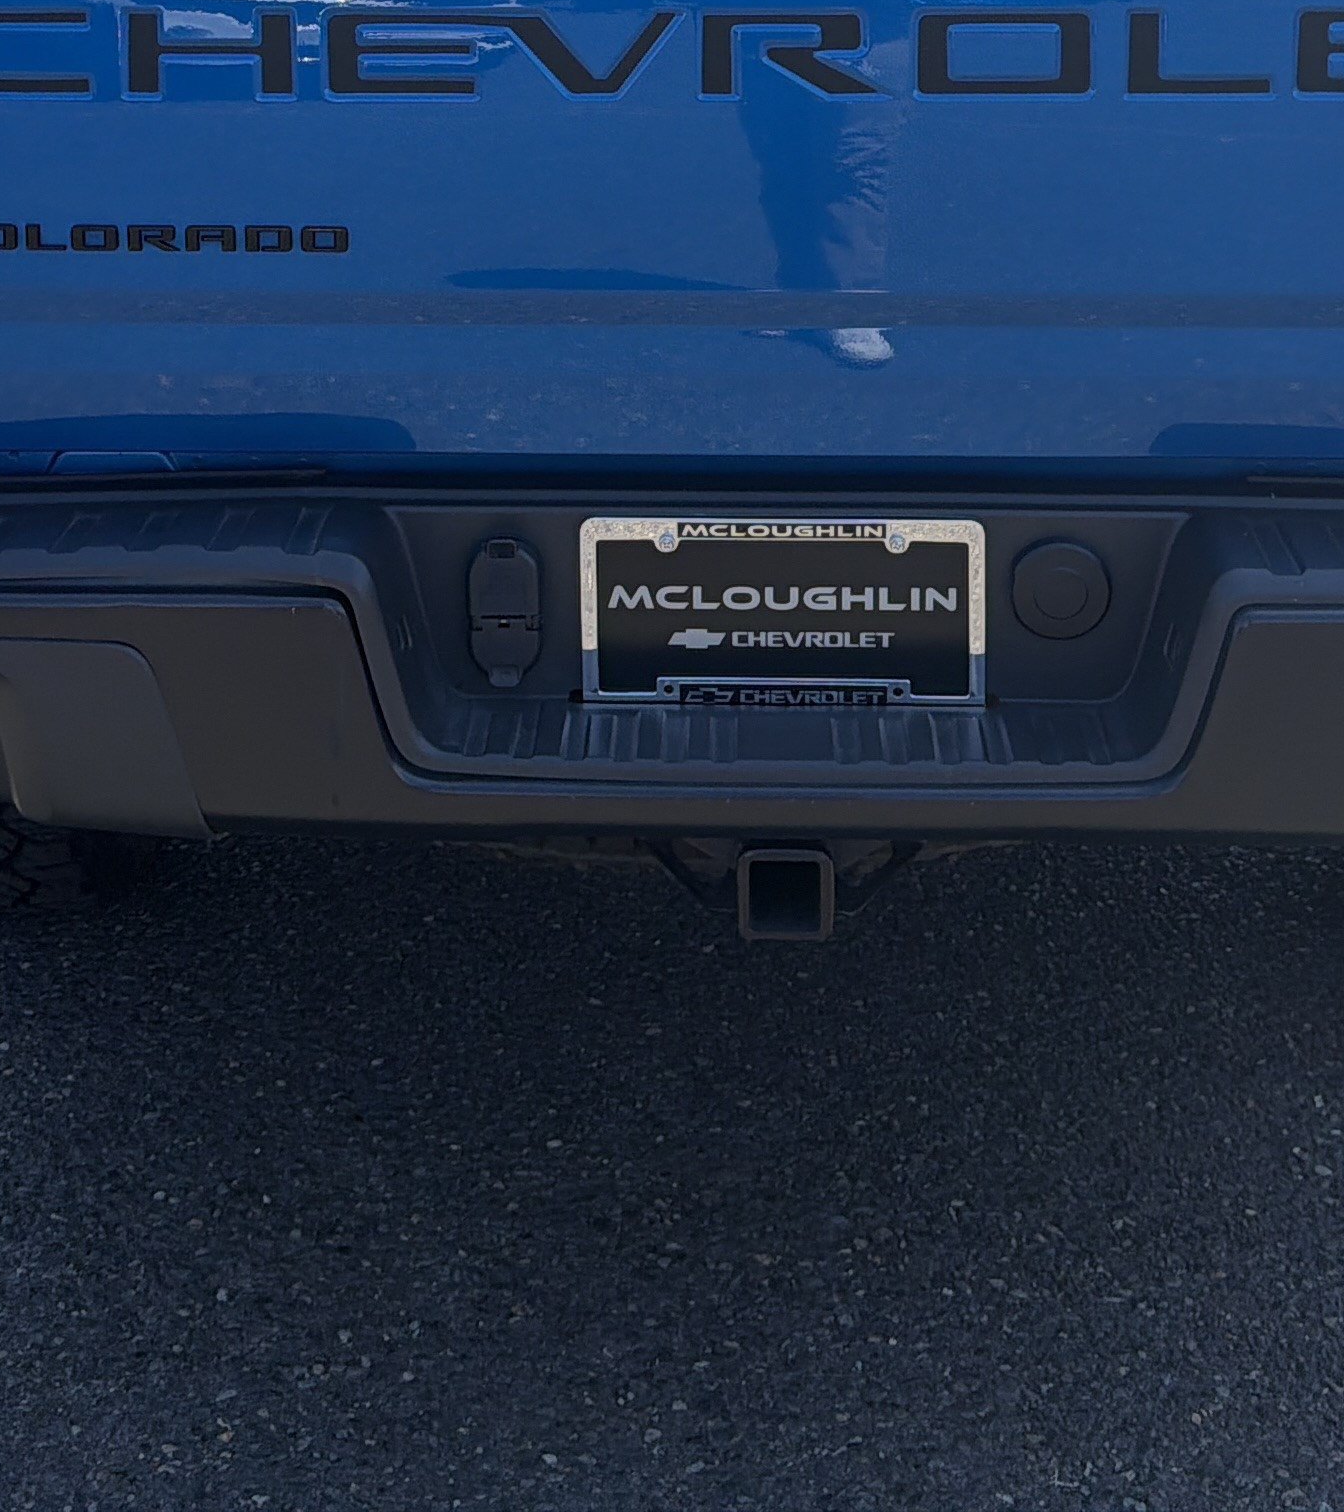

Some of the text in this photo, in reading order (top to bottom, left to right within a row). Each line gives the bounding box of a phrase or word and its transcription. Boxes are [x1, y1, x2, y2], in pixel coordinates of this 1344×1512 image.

[681, 523, 884, 539] MCLOUGHLIN
[607, 585, 957, 611] MCLOUGHLIN
[731, 631, 896, 649] CHEVROLET
[739, 688, 885, 706] CHEVROLET
